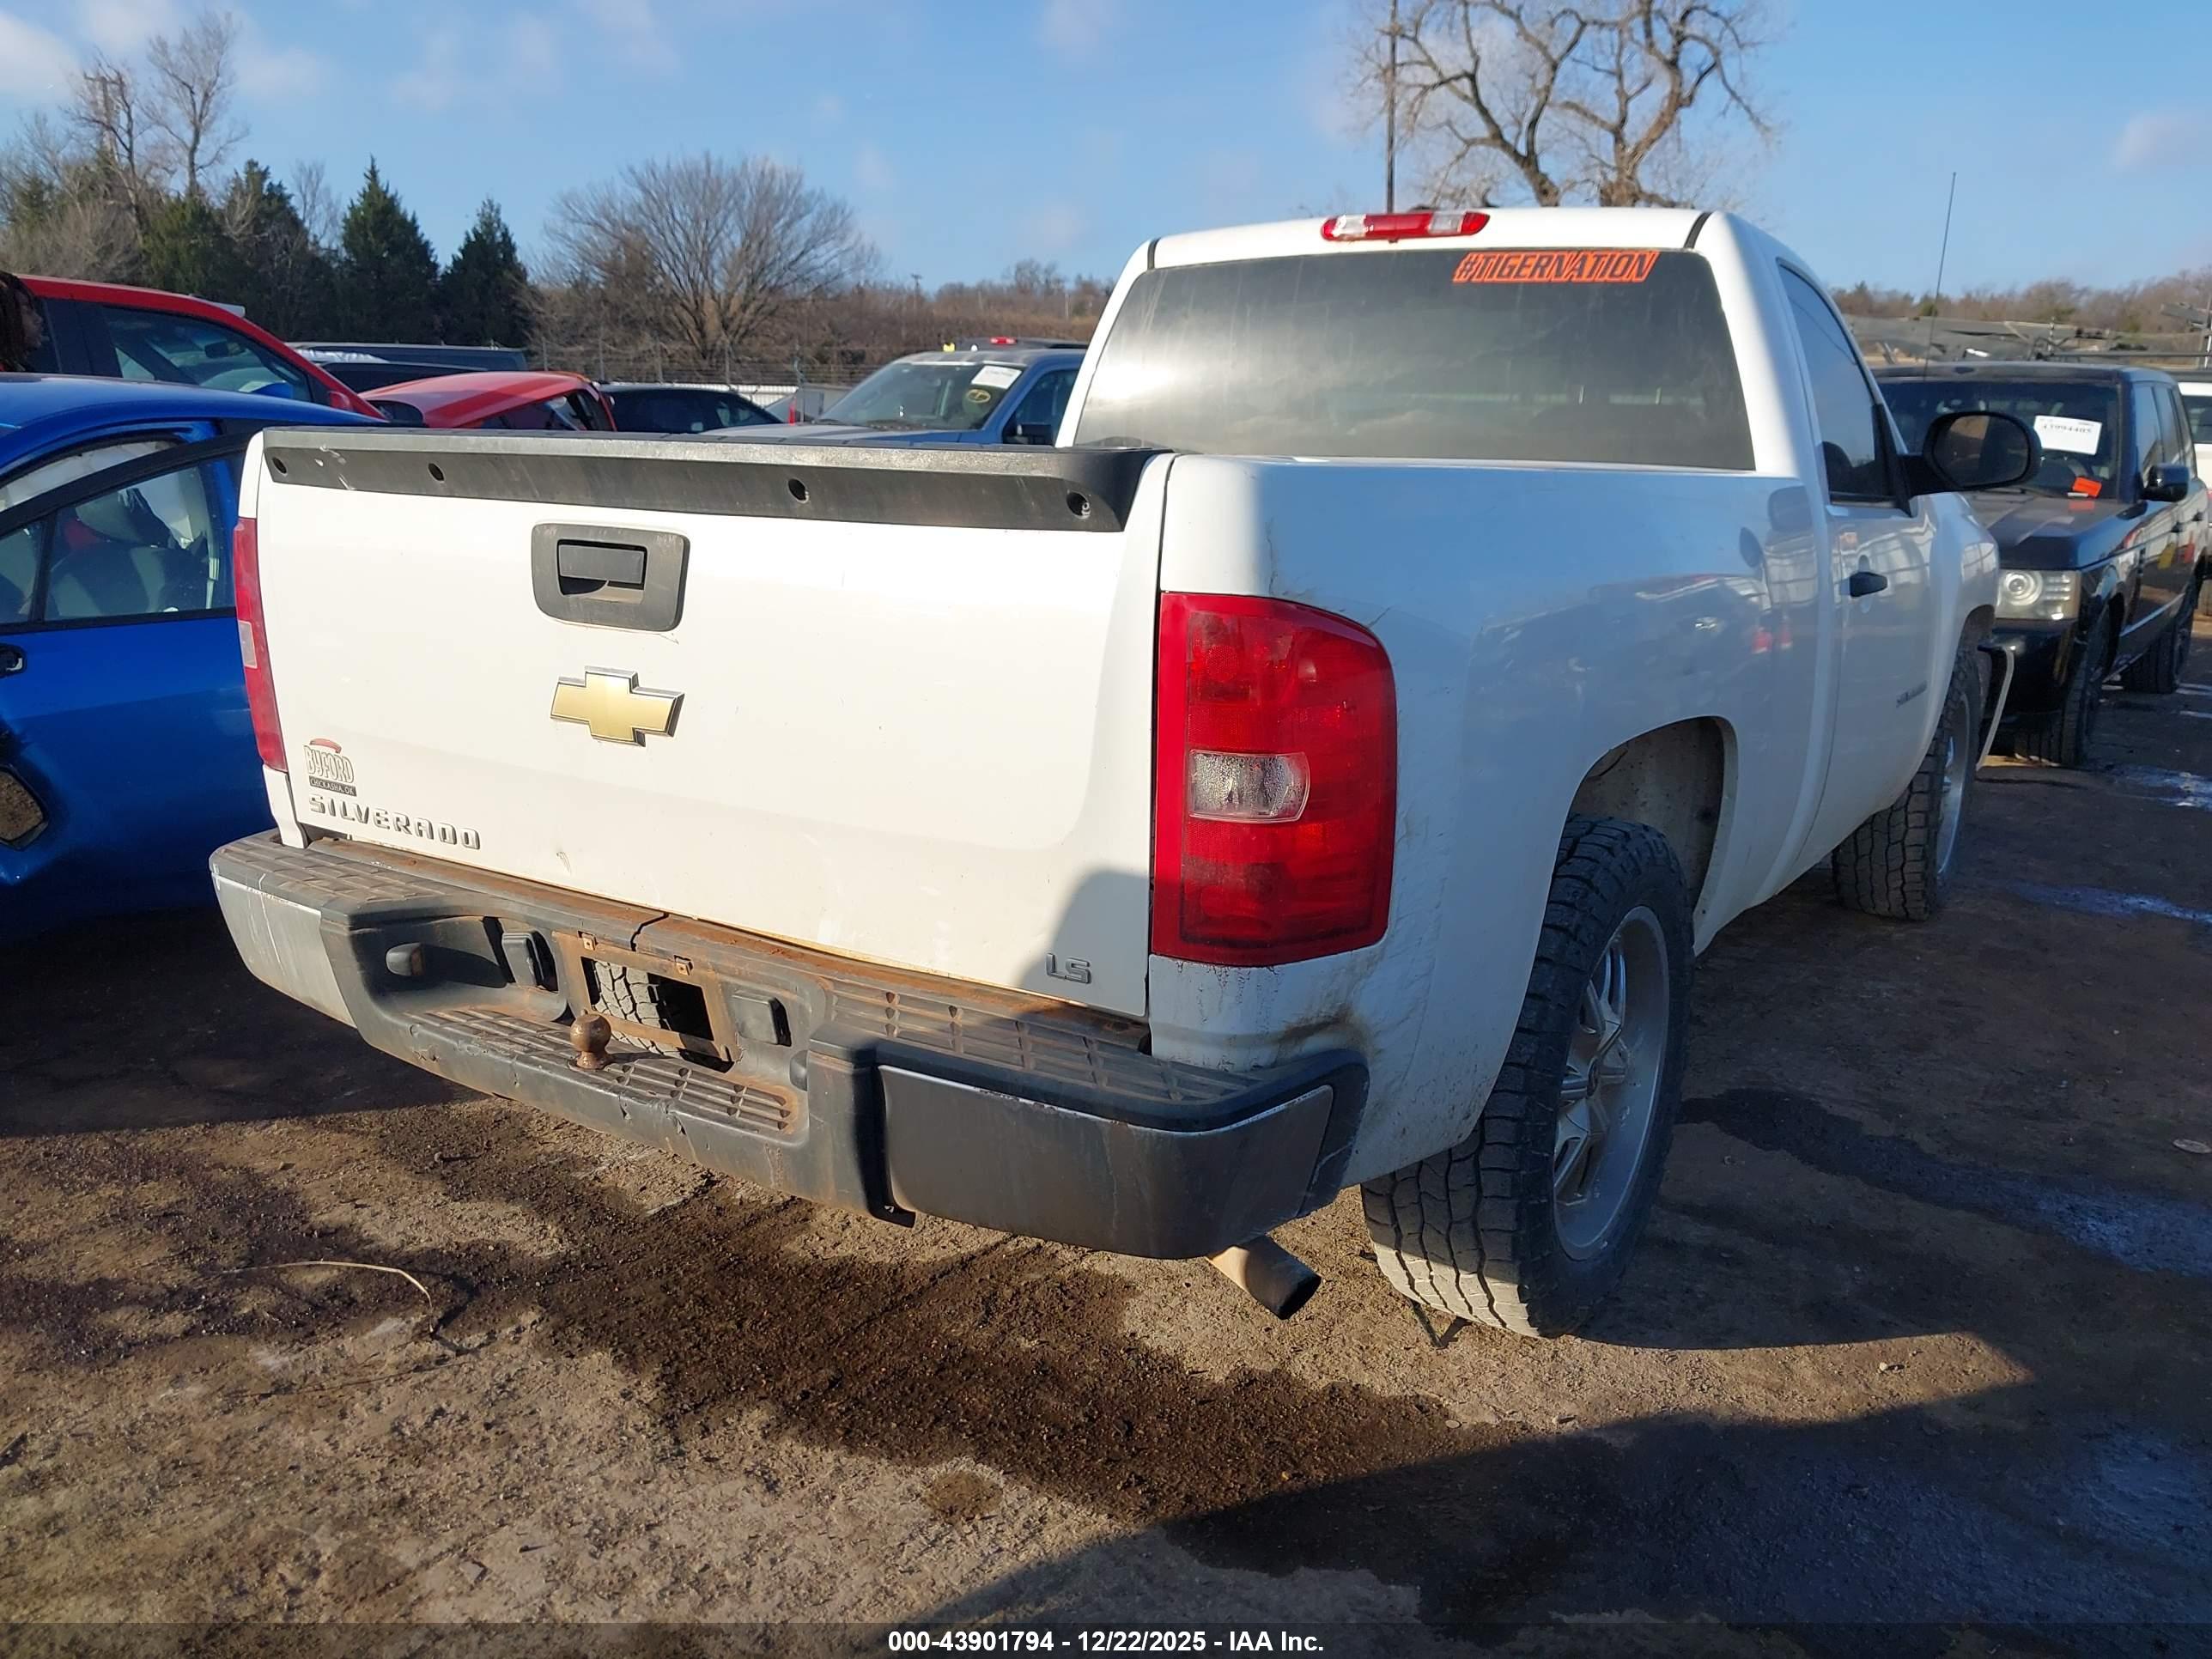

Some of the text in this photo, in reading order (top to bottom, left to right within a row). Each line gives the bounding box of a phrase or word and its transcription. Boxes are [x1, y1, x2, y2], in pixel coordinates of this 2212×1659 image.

[1454, 251, 1659, 283] #TIGERNATION
[303, 744, 355, 784] BYFORD
[344, 784, 355, 796] OK
[309, 793, 481, 850] SILVERADO
[1046, 952, 1092, 984] LS
